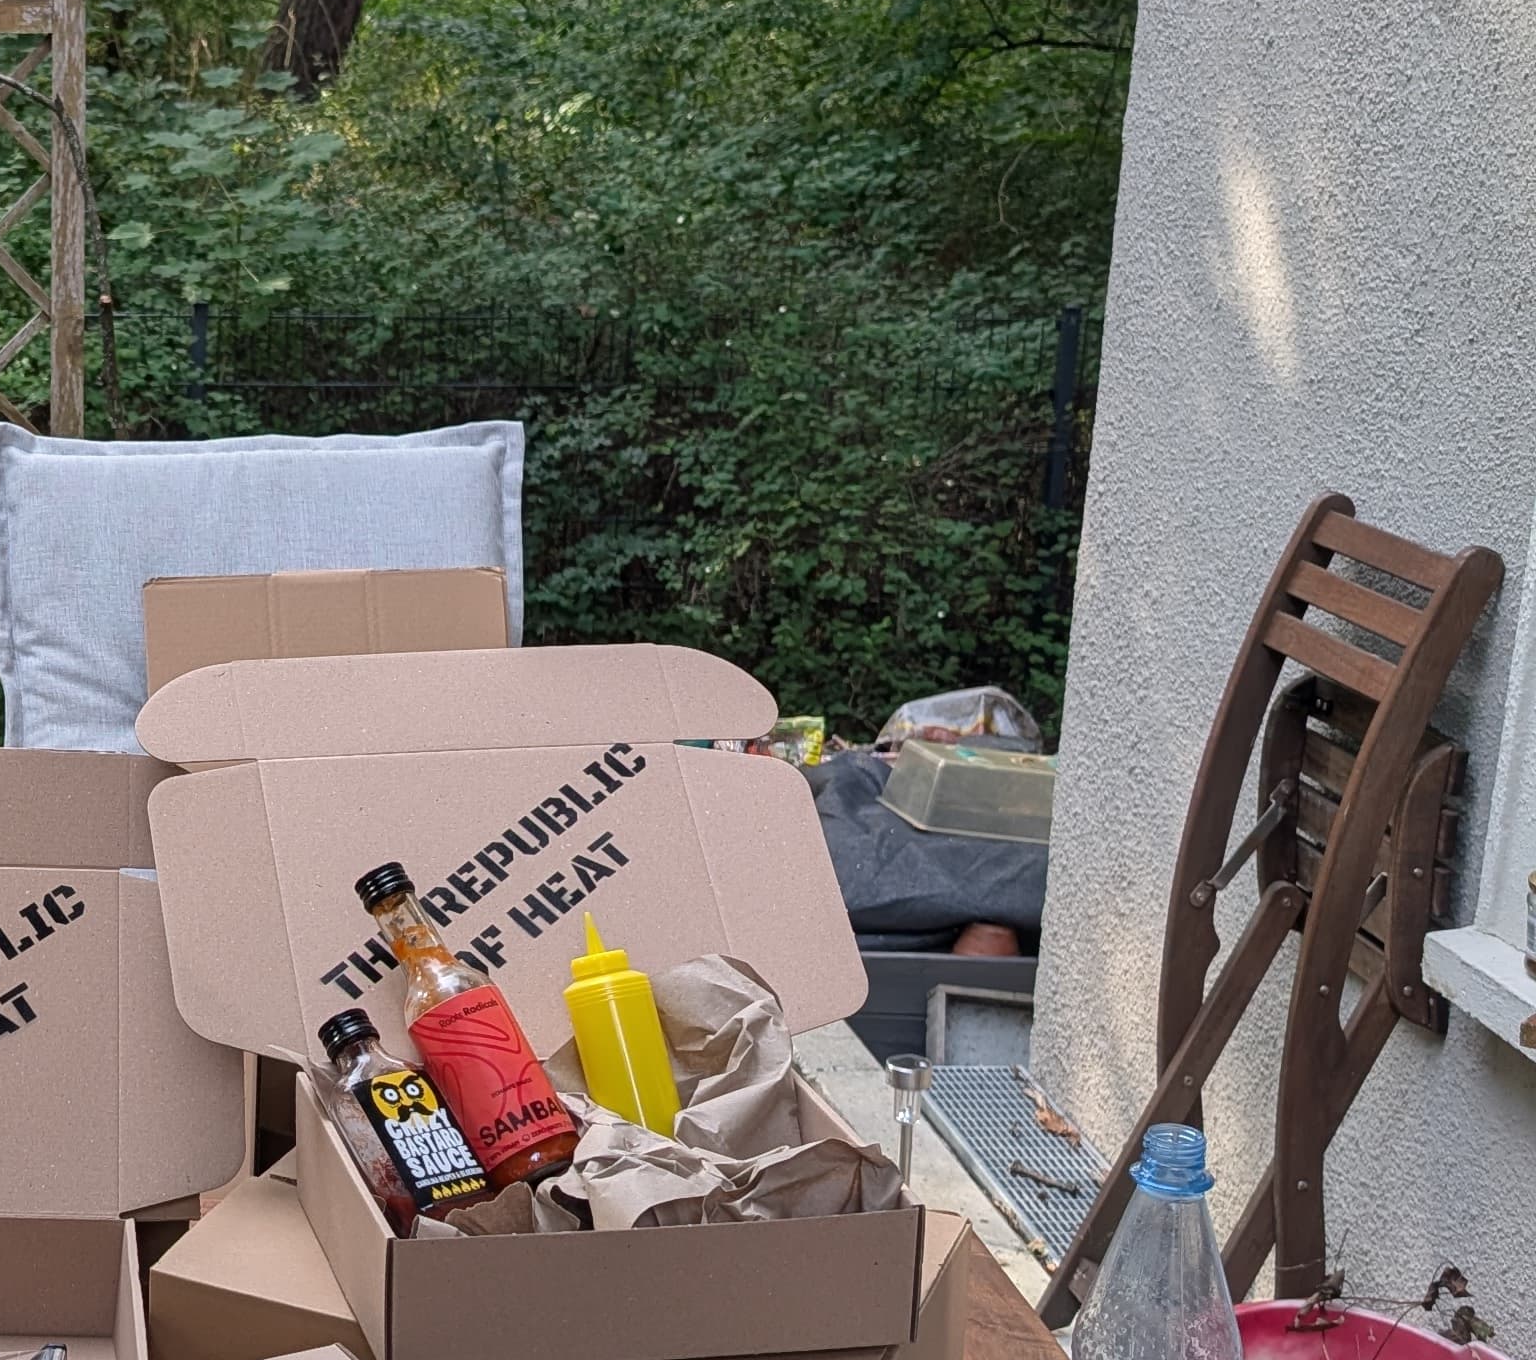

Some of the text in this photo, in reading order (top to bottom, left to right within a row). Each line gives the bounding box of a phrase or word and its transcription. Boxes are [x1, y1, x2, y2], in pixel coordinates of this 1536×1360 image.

[419, 742, 647, 928] REPUBLIC
[506, 831, 630, 939] HEAT
[439, 998, 499, 1029] Roots Radicals
[384, 1108, 452, 1139] CRAZY
[393, 1127, 464, 1159] BASTARD
[406, 1145, 478, 1178] SAUCE
